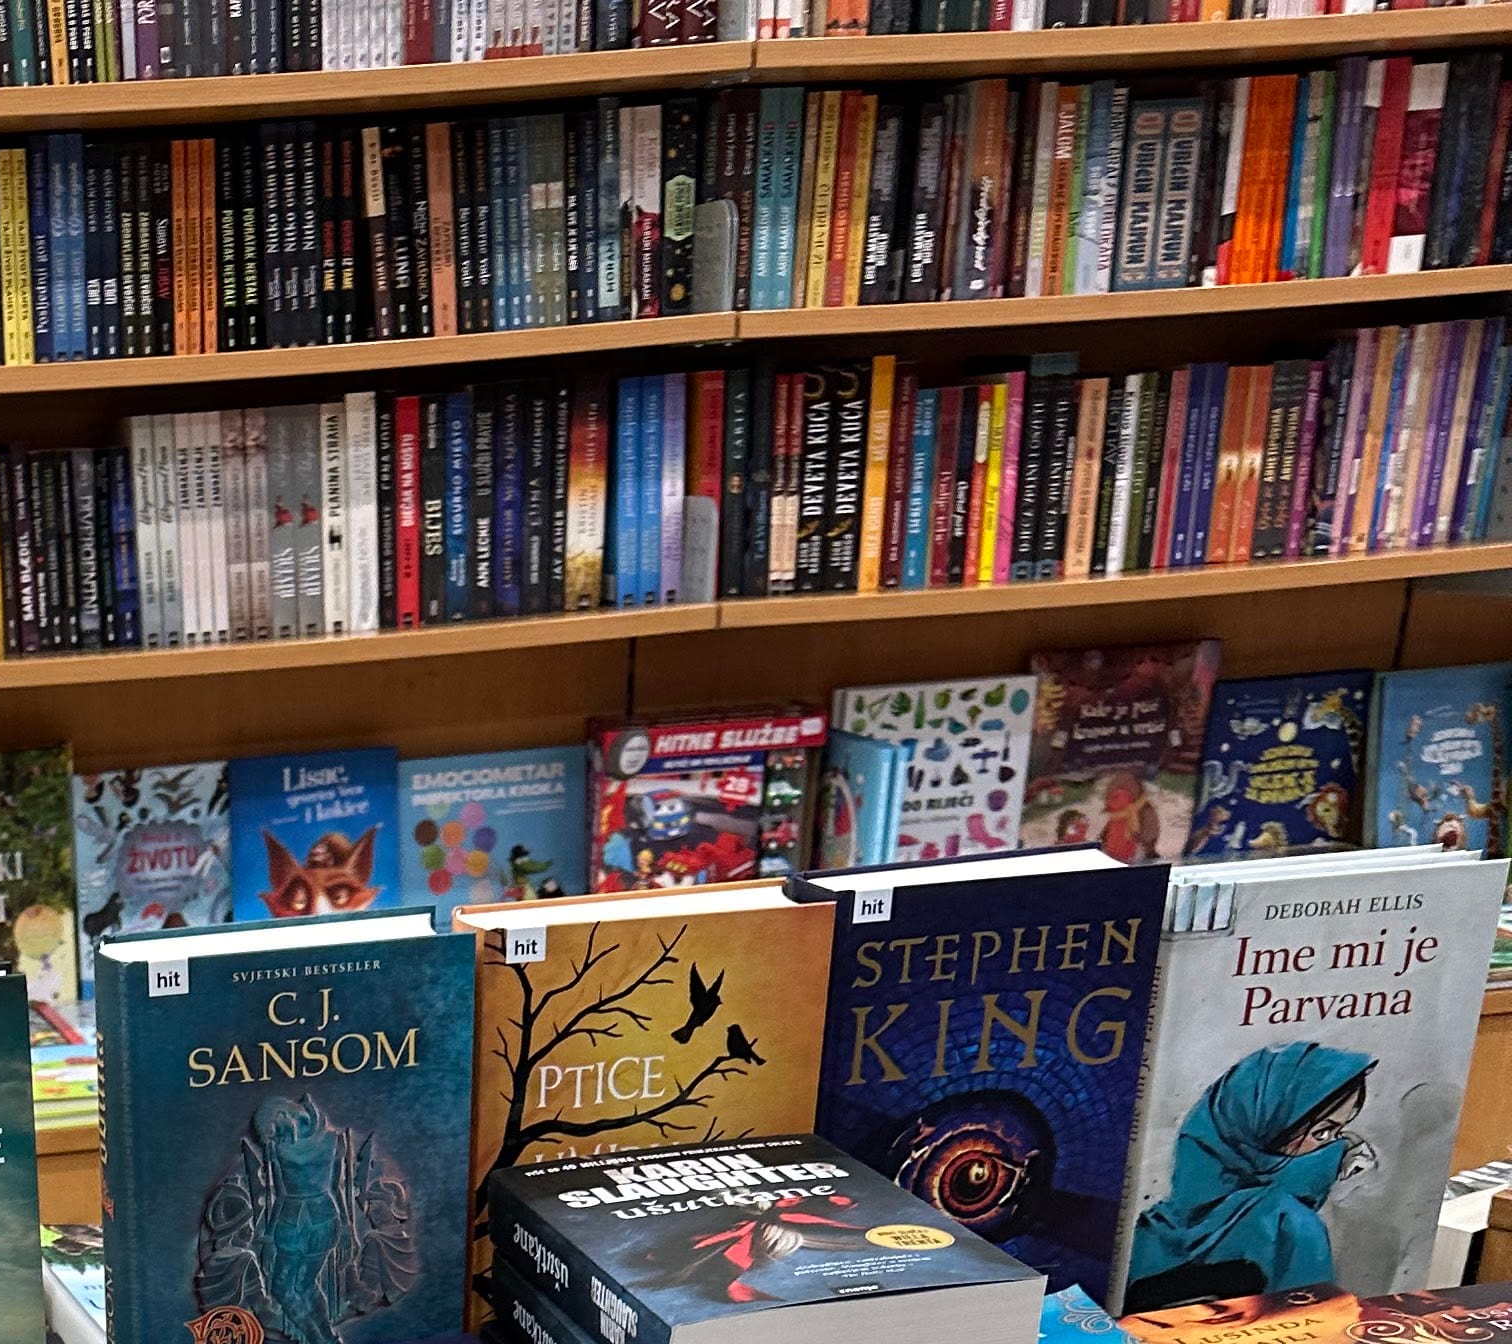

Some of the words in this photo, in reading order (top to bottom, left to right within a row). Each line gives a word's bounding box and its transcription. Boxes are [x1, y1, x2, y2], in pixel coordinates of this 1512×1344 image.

[328, 470, 340, 518] PLANINA
[802, 447, 824, 517] DEVETA
[836, 444, 858, 516] DEVETA
[654, 731, 717, 754] HITNE
[719, 723, 799, 749] SLUŽBE
[861, 899, 885, 916] hit
[1264, 898, 1361, 921] DEBORAH
[1369, 894, 1424, 913] ELLIS
[514, 938, 538, 955] hit
[851, 918, 1142, 988] STEPHEN
[1231, 936, 1316, 977] Ime
[1329, 929, 1388, 969] mi
[1394, 926, 1439, 976] je
[156, 970, 181, 989] hit
[232, 967, 297, 984] SVJETSKI
[304, 959, 382, 977] BESTSELER
[268, 991, 306, 1027] C.
[318, 988, 339, 1031] J.
[1239, 987, 1412, 1026] Parvana
[189, 1028, 420, 1088] SANSOM
[845, 987, 1132, 1086] KING
[536, 1056, 666, 1109] PTICE
[557, 1161, 850, 1208] SLAUGHTER
[606, 1154, 764, 1186] KARIN
[610, 1184, 837, 1220] ušutkane
